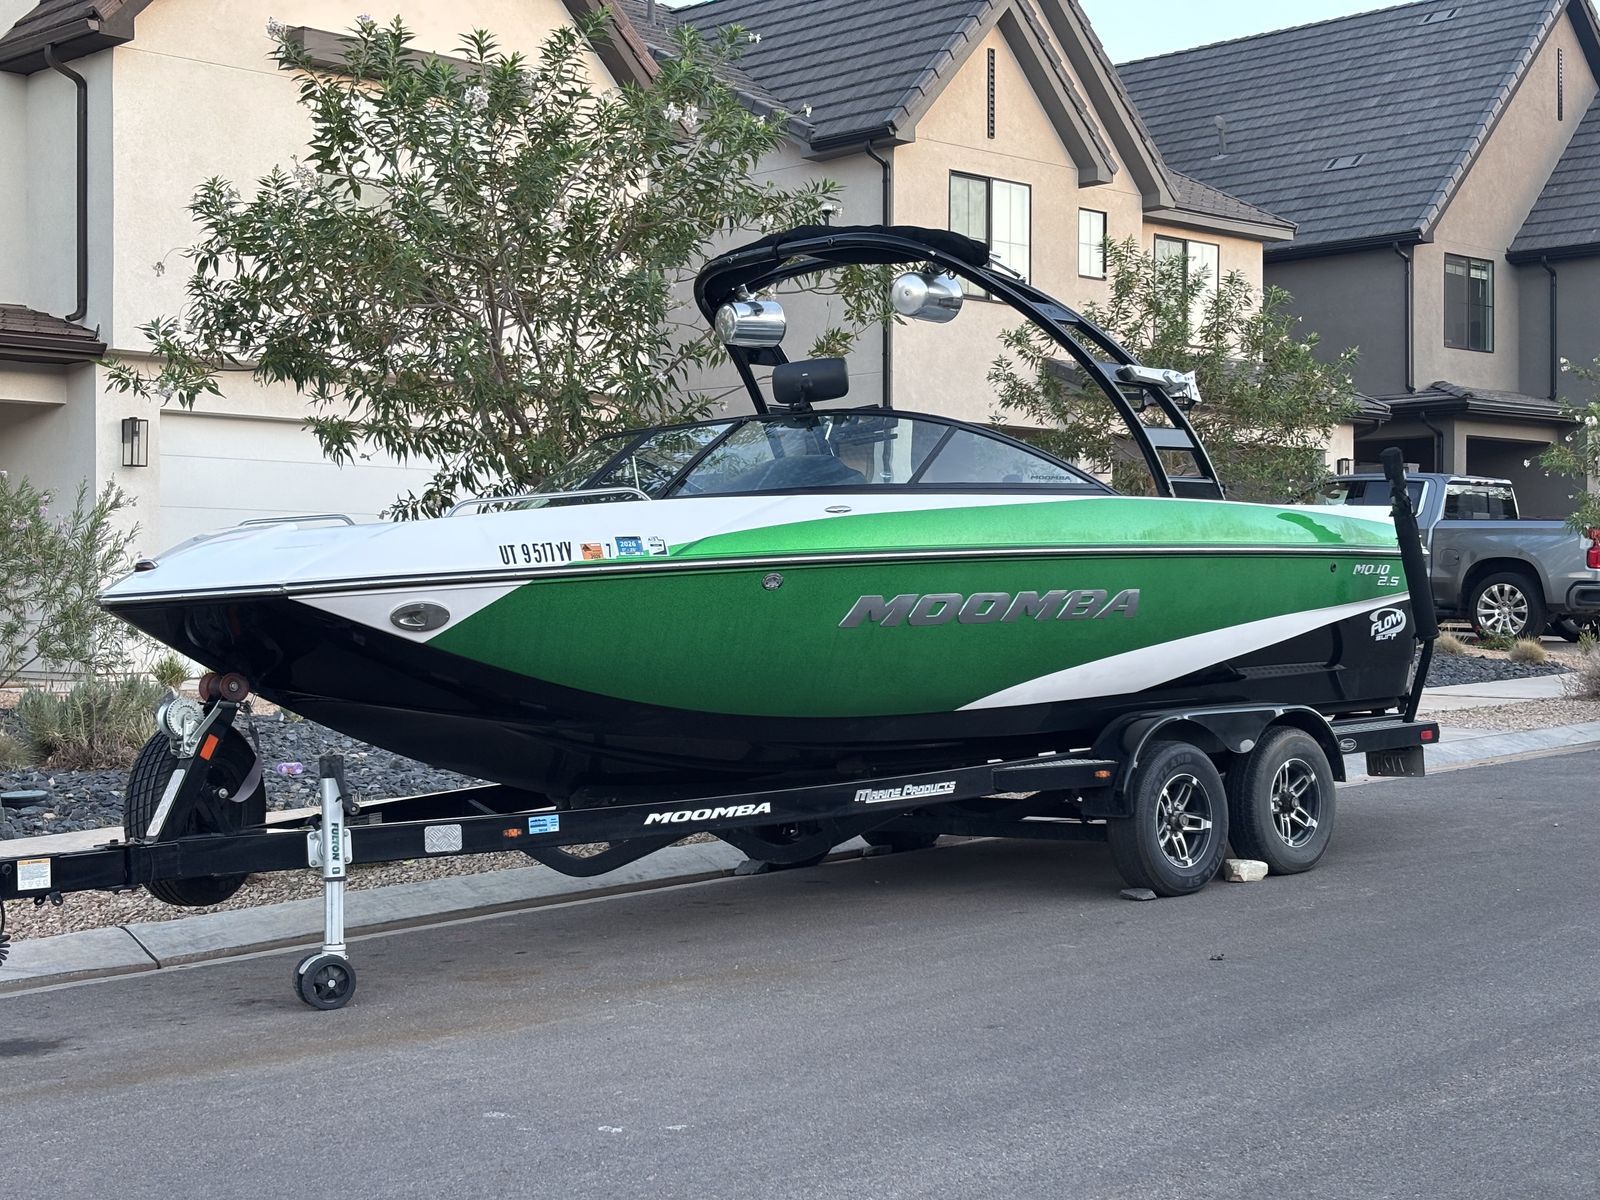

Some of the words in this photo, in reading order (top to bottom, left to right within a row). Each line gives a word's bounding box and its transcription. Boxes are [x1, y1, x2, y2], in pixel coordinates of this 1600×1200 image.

[499, 544, 517, 565] UT
[1353, 564, 1390, 575] MOJO
[1377, 576, 1400, 586] 2.5
[838, 588, 1140, 628] MOOMBA
[1371, 610, 1403, 637] FLOW
[643, 802, 771, 825] MOOMBA
[331, 823, 341, 861] FULTON
